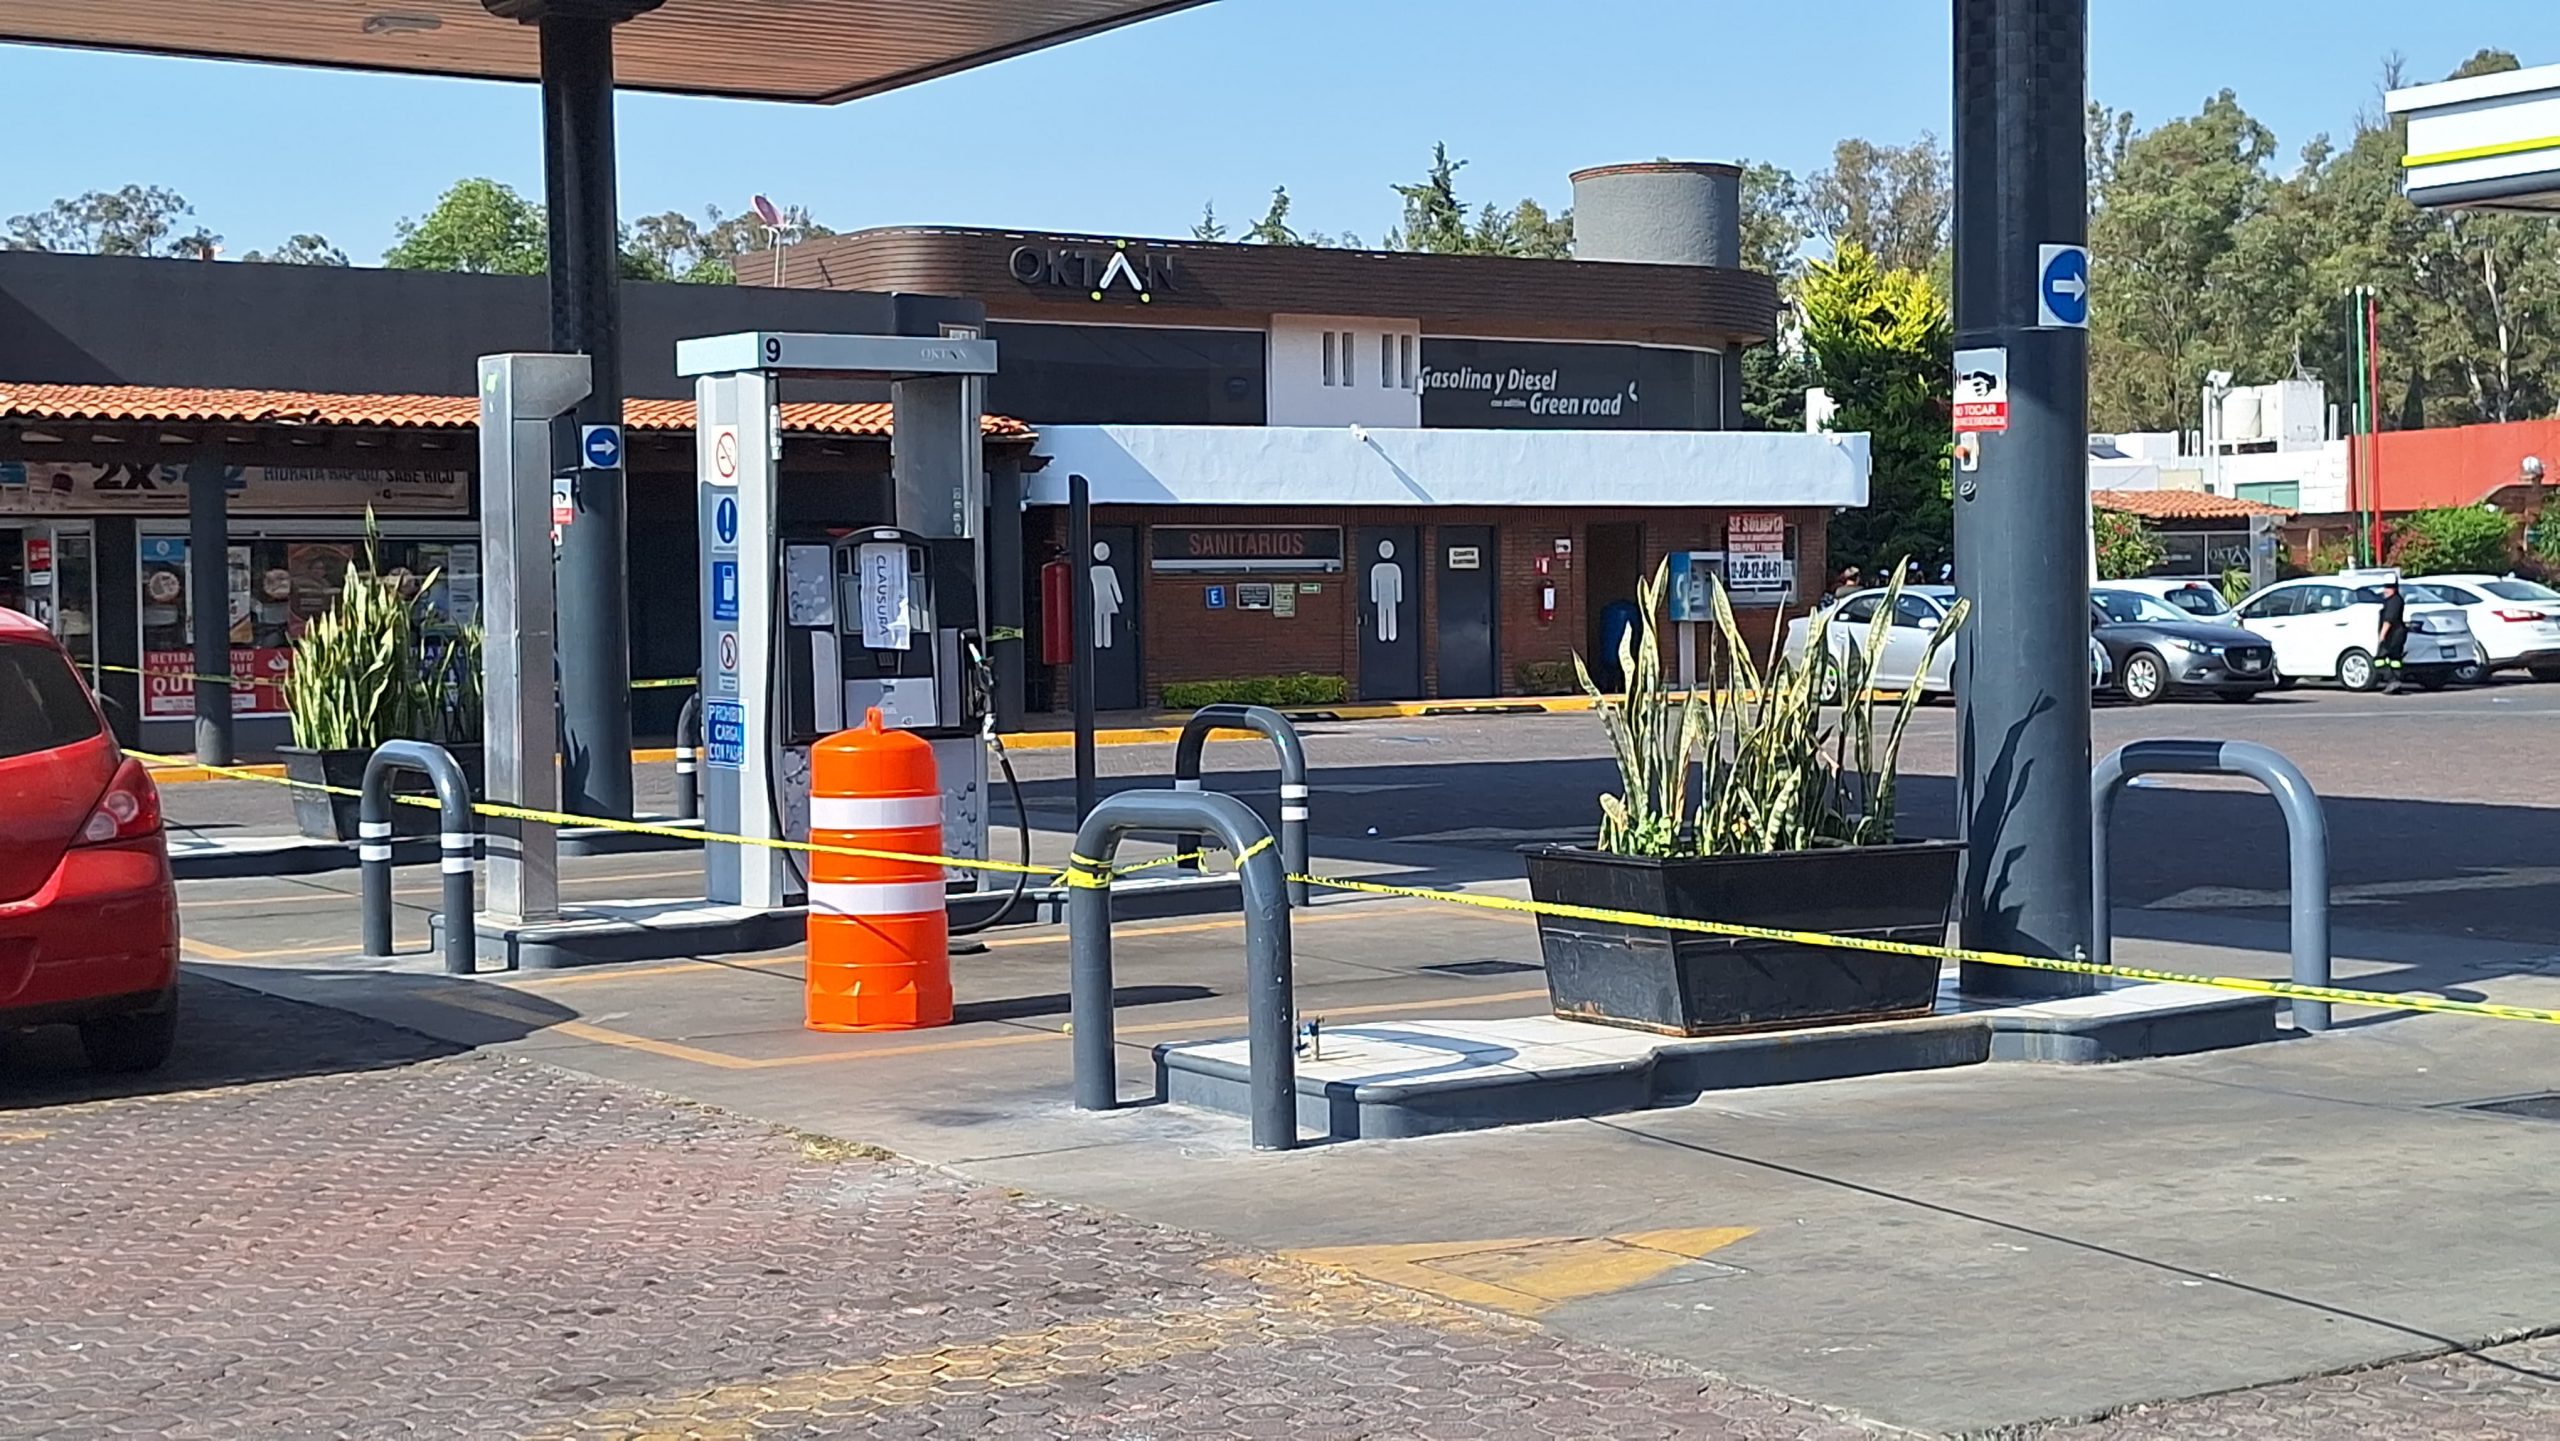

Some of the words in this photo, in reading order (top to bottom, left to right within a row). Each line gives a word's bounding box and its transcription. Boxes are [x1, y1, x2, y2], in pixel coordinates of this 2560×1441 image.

[1009, 242, 1178, 303] OKTAN
[765, 337, 782, 363] 9
[1421, 366, 1492, 390] Gasolina
[1494, 373, 1505, 395] y
[1507, 369, 1558, 391] Diesel
[1529, 392, 1580, 415] Green
[1582, 393, 1622, 416] road
[1965, 403, 1998, 415] TOCAR
[1189, 532, 1304, 556] SANITARIOS
[876, 555, 889, 636] CLAUSURA
[1210, 590, 1220, 604] E
[150, 652, 195, 665] RETIRA
